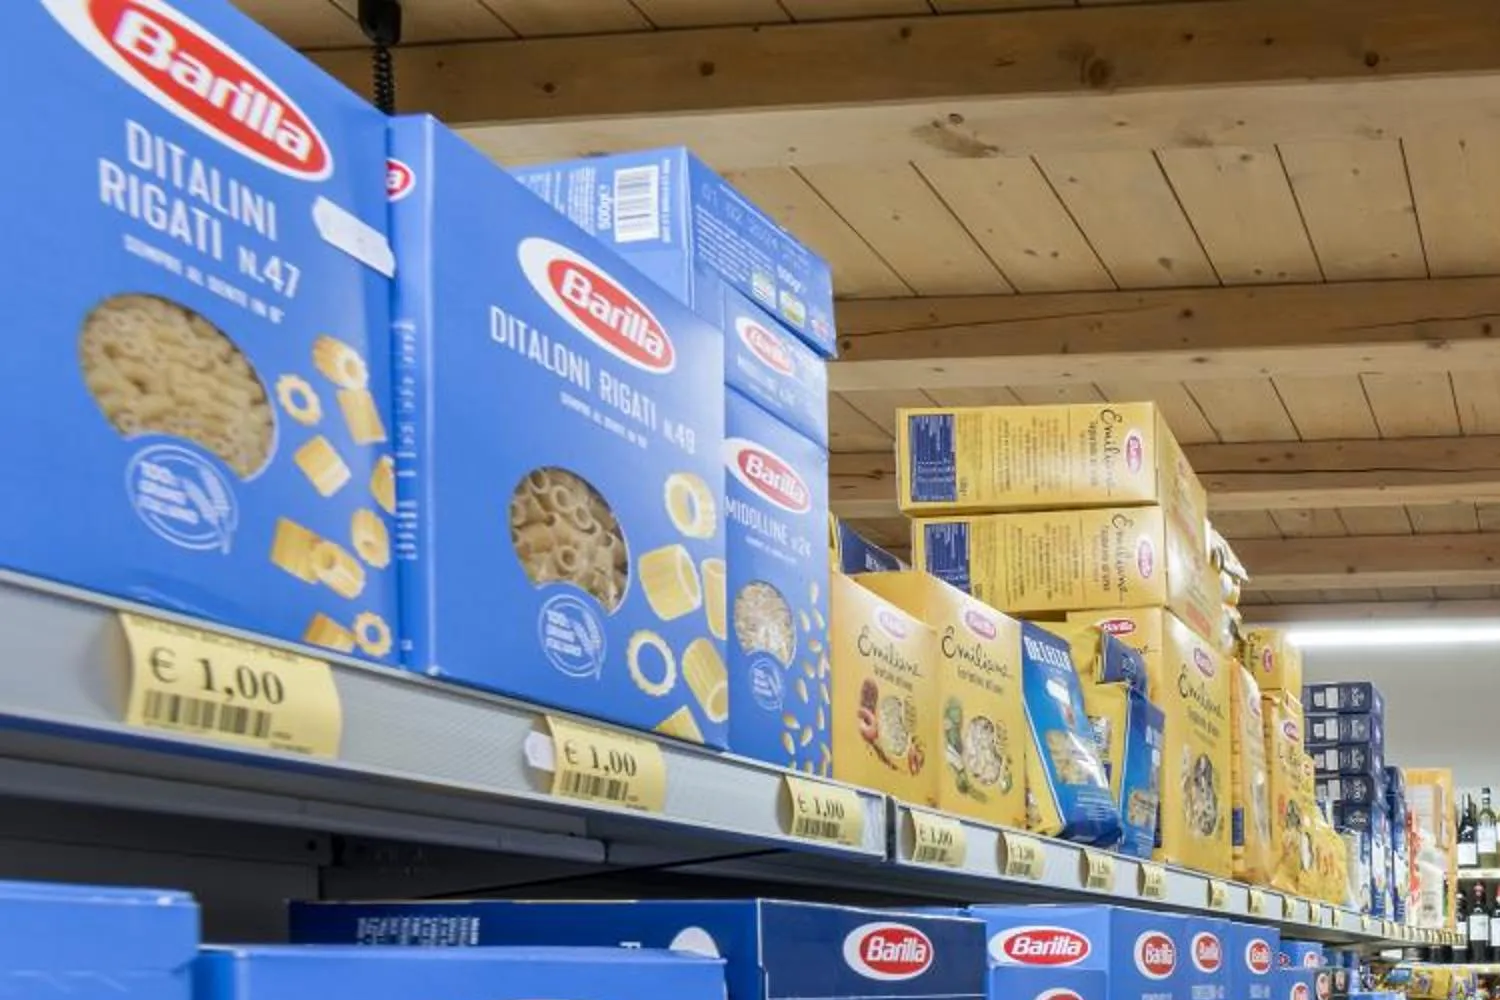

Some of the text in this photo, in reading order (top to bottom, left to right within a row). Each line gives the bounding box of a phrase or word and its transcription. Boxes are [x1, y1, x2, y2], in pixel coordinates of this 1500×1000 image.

[112, 8, 314, 162] Barilla
[126, 118, 279, 241] DITALINI
[99, 158, 223, 262] RIGATI
[562, 269, 667, 359] Barilla
[489, 306, 592, 391] DITALONI
[599, 369, 657, 431] RIGATI
[746, 455, 808, 505] Barilla
[725, 495, 789, 545] MIDOLLINE
[150, 646, 286, 705] € 1,00
[589, 743, 638, 777] 1,00
[867, 935, 927, 964] Barilla
[1011, 936, 1083, 956] Barilla
